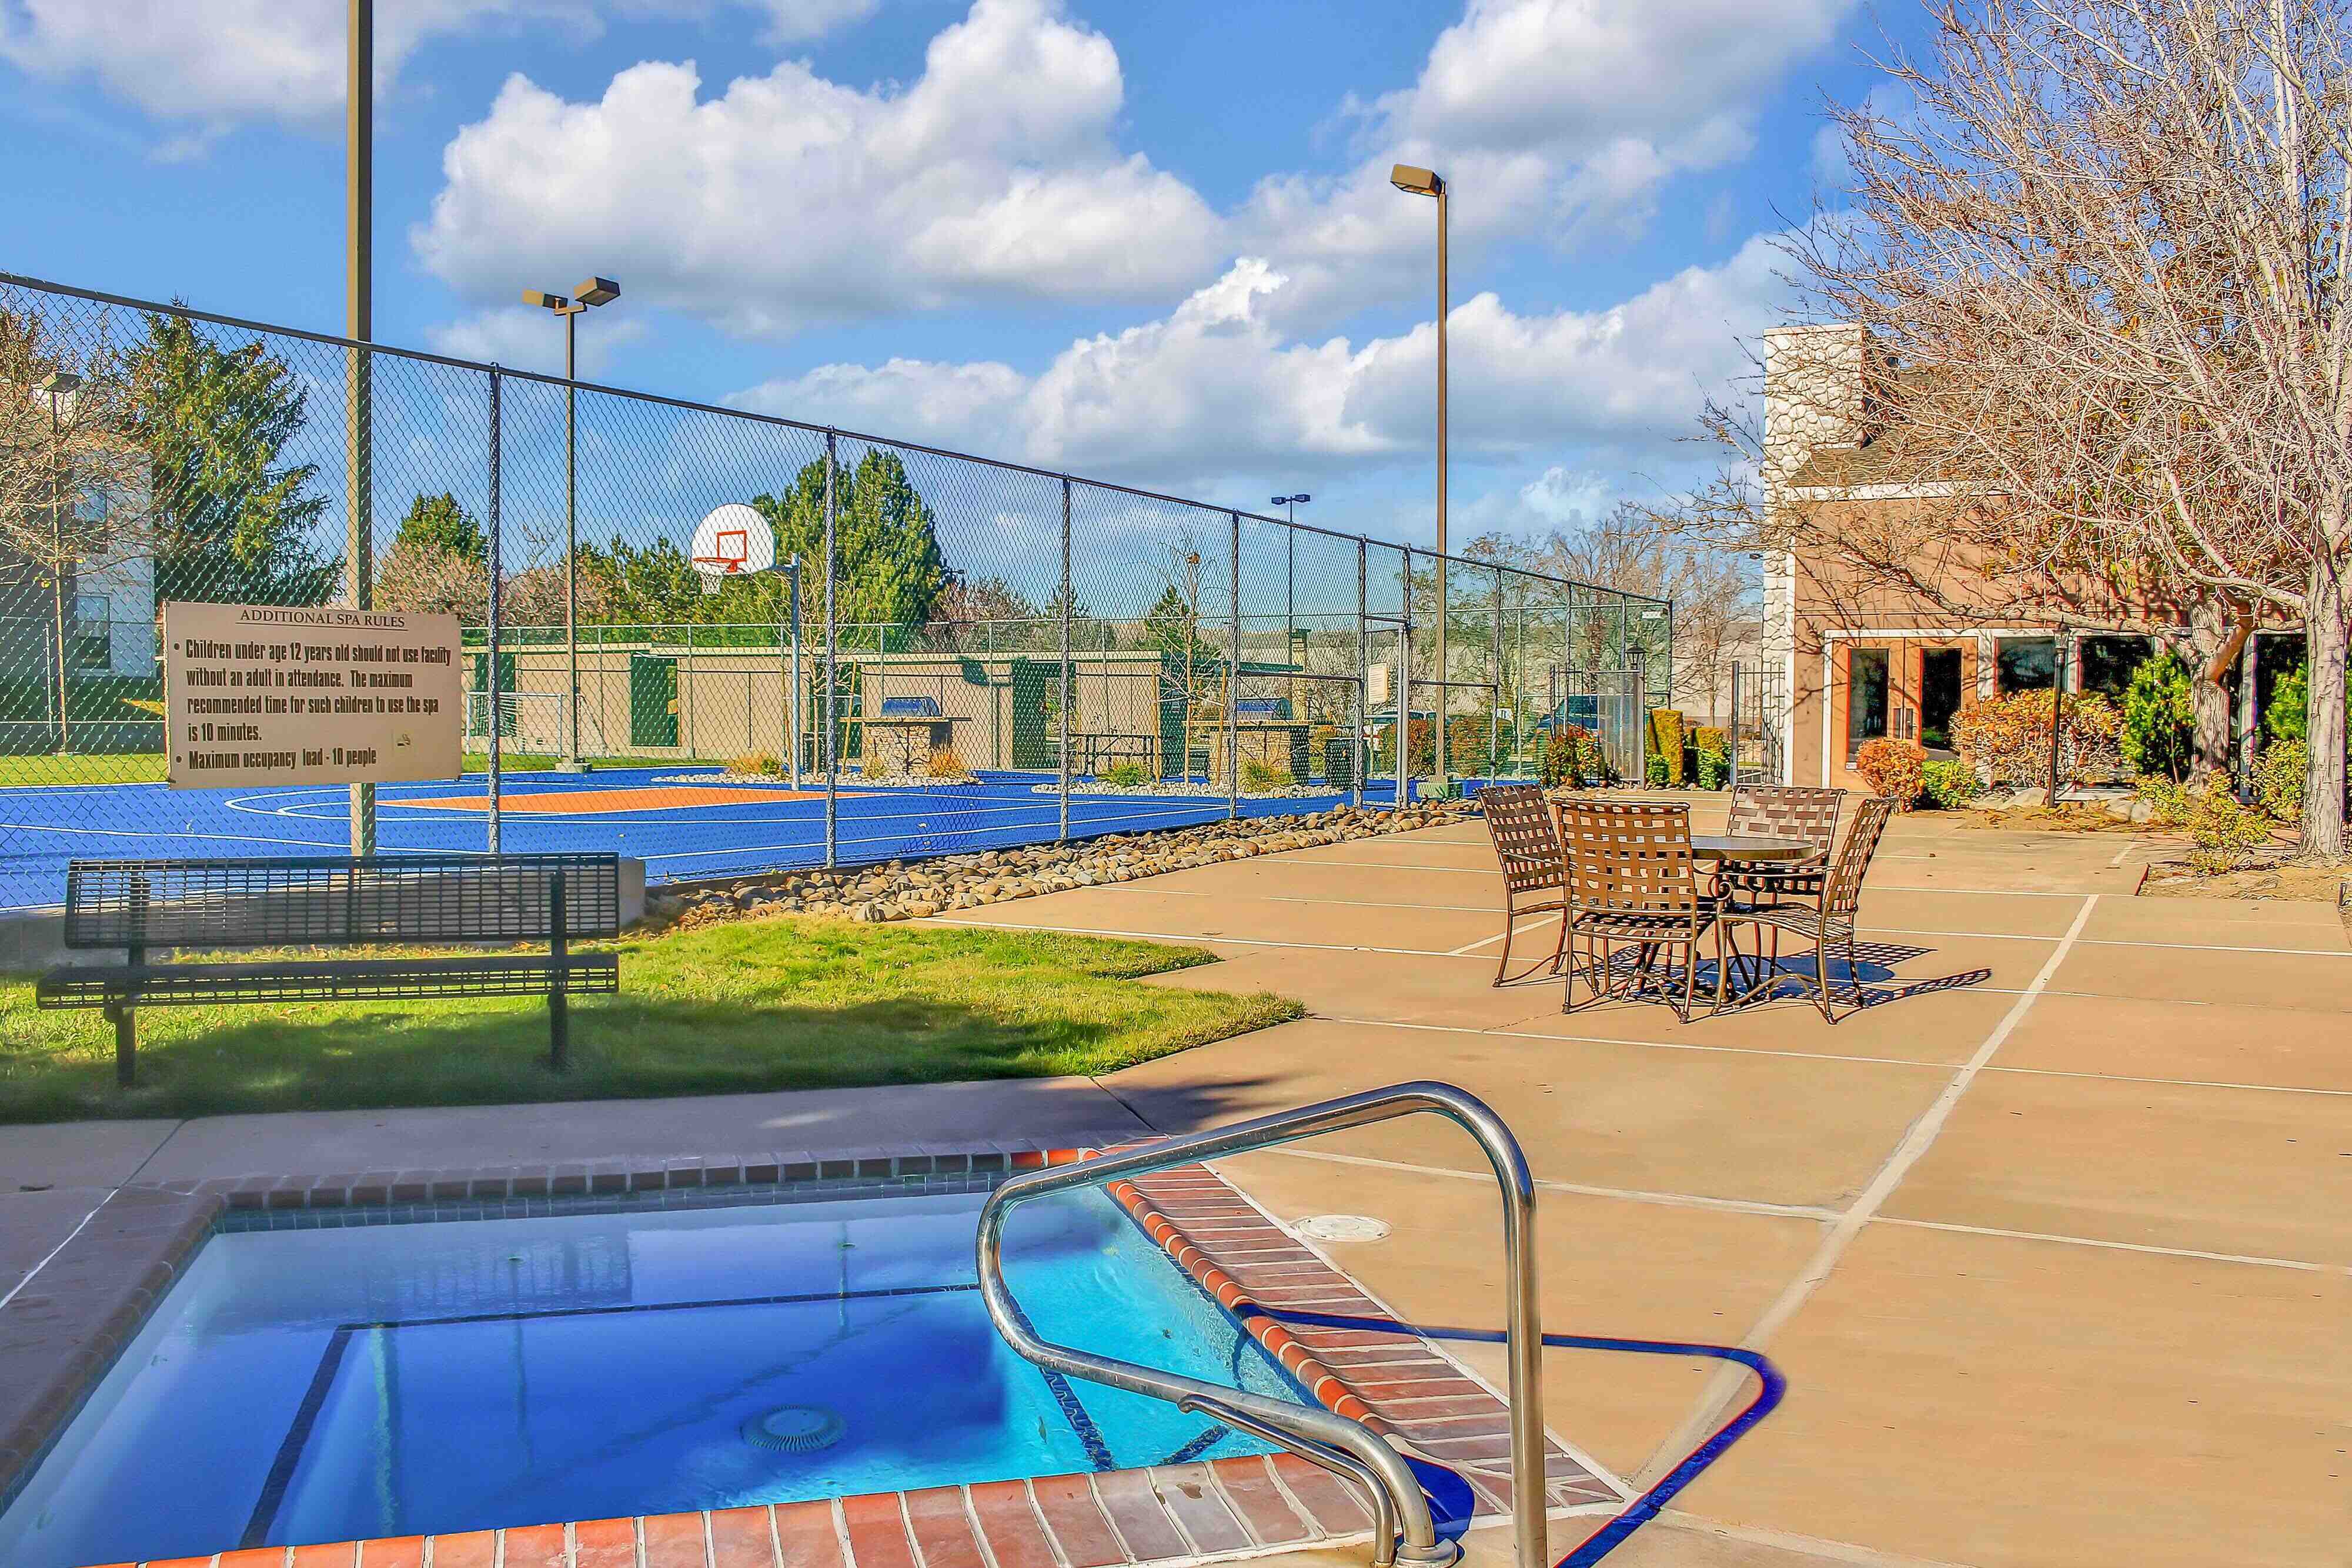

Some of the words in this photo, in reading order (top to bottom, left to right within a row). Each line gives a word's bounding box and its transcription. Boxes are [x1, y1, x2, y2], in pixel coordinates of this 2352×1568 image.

[240, 609, 333, 624] ADDITIONAL
[337, 614, 360, 626] SPA
[365, 615, 405, 627] RULES
[186, 638, 232, 659] Children
[235, 641, 266, 660] under
[269, 644, 287, 663] age
[290, 642, 302, 660] 12
[304, 645, 332, 664] years
[335, 644, 349, 661] old
[352, 644, 383, 662] should
[386, 646, 400, 663] not
[403, 648, 419, 663] use
[421, 646, 452, 666] facility
[186, 667, 227, 686] without
[230, 670, 243, 687] an
[246, 668, 272, 687] adult
[275, 668, 285, 687] in
[288, 668, 345, 687] attendance.
[350, 670, 366, 688] The
[369, 670, 413, 688] maximum
[188, 695, 262, 714] recommended
[265, 695, 287, 713] time
[290, 695, 305, 713] for
[309, 696, 331, 713] such
[335, 696, 373, 713] children
[376, 696, 385, 713] to
[388, 698, 404, 713] use
[406, 696, 420, 713] the
[423, 698, 439, 716] spa
[188, 723, 198, 741] is
[201, 723, 213, 741] 10
[217, 723, 262, 741] minutes.
[189, 750, 240, 769] Maximum
[243, 751, 296, 770] occupancy
[303, 747, 323, 766] load
[333, 747, 343, 765] 10
[346, 747, 376, 768] people
